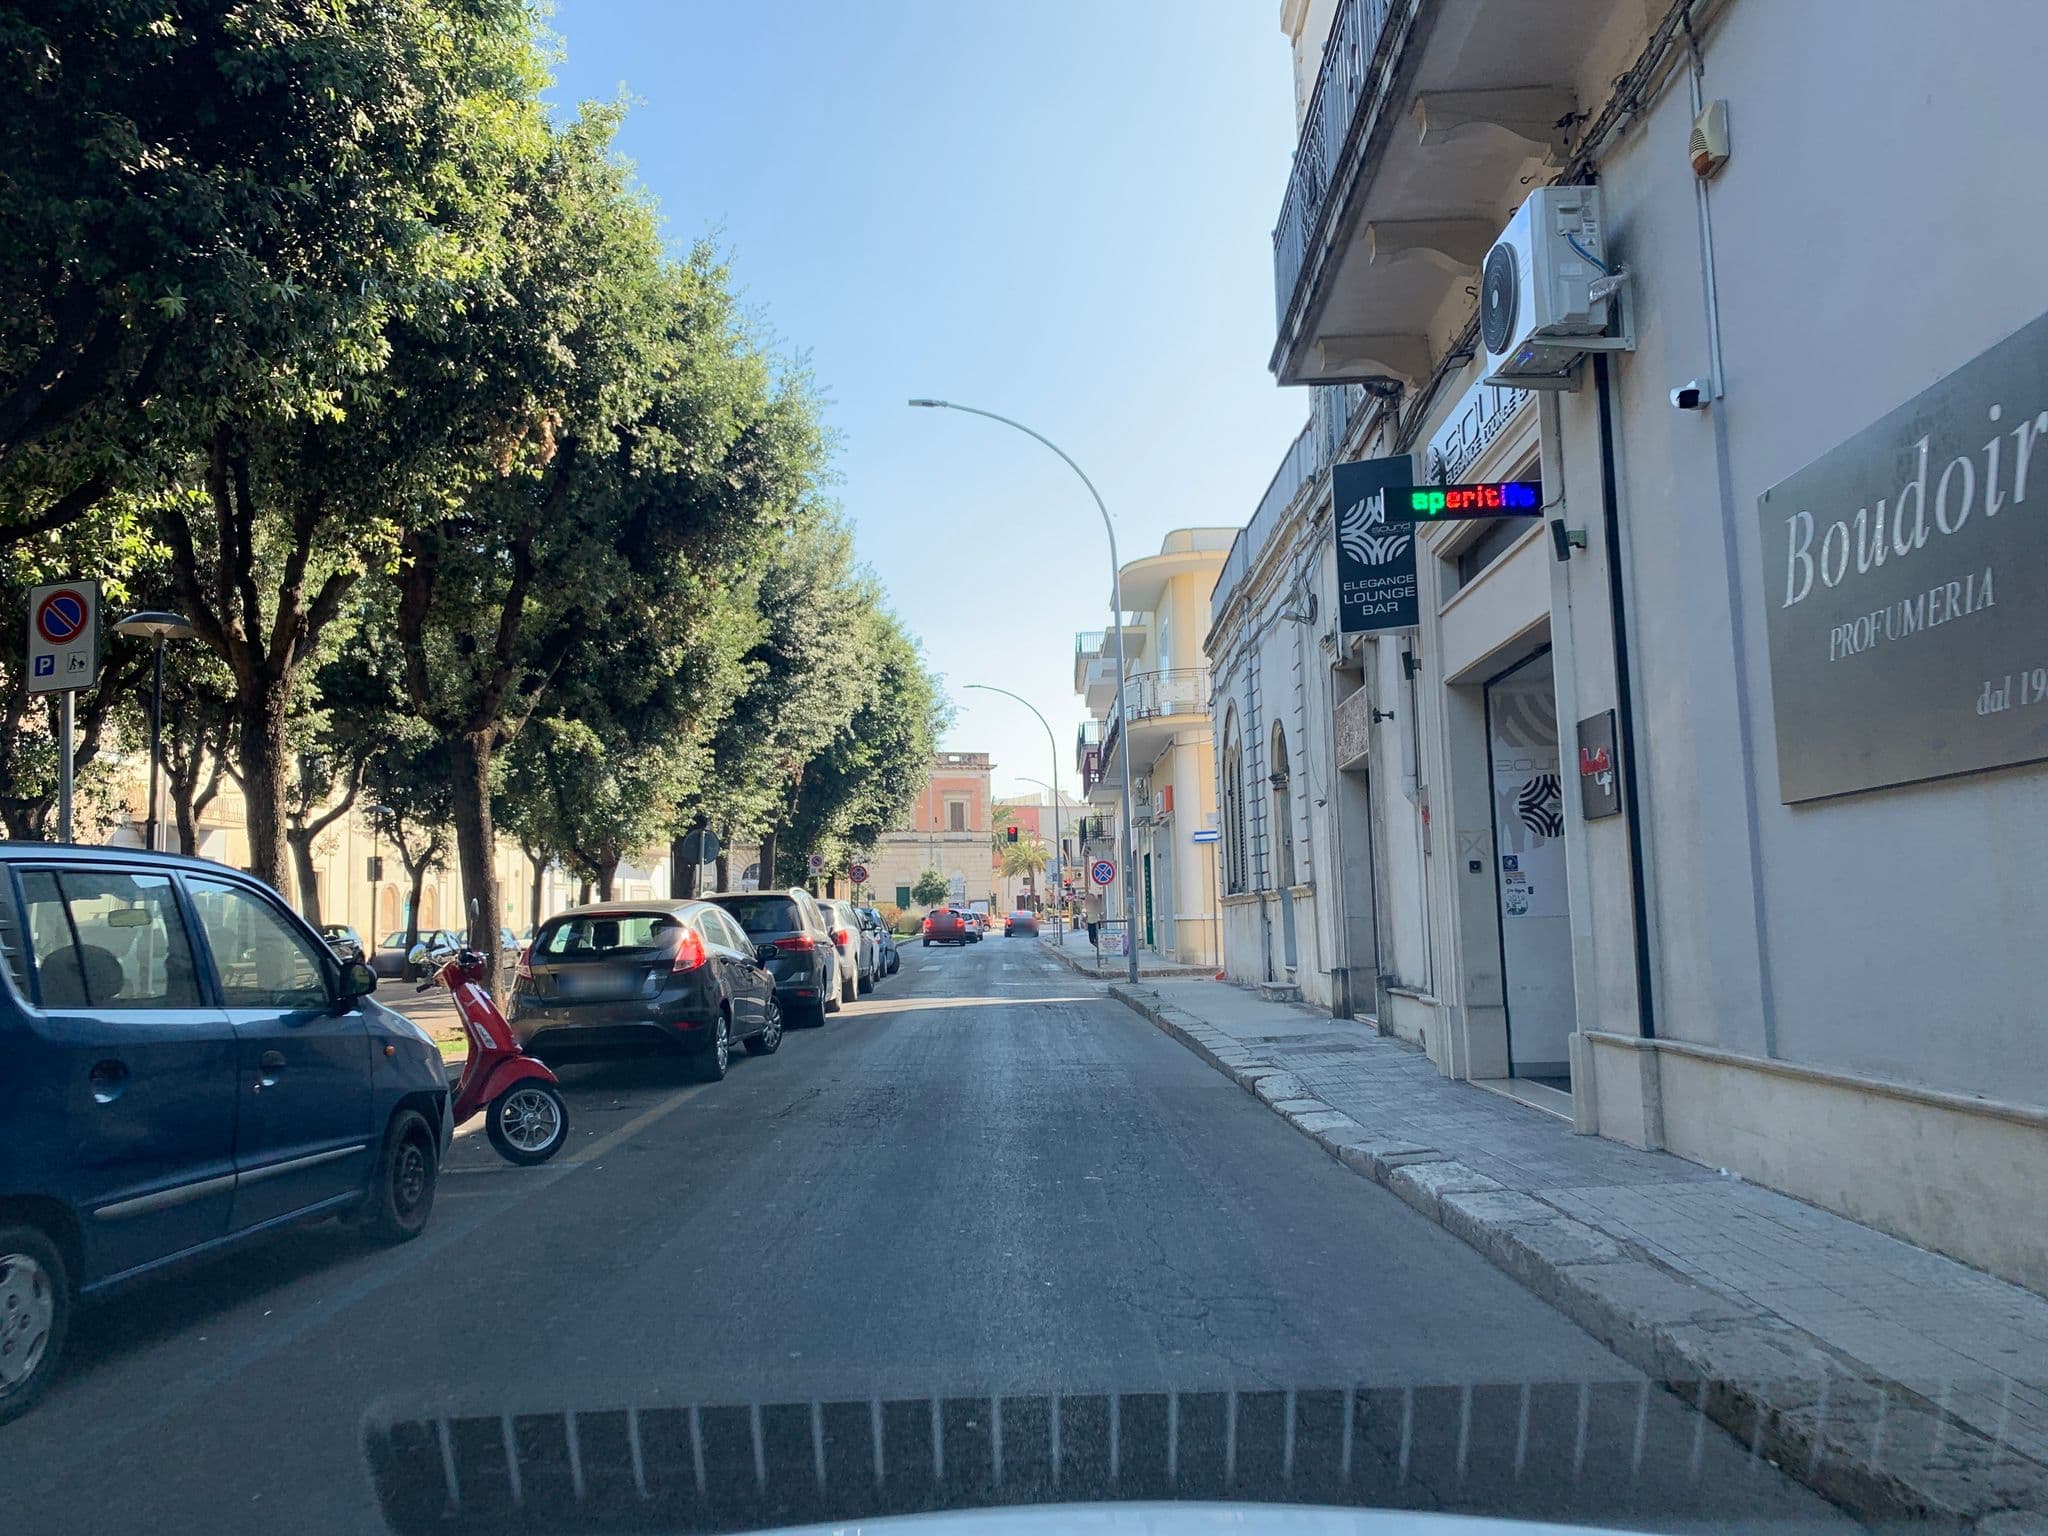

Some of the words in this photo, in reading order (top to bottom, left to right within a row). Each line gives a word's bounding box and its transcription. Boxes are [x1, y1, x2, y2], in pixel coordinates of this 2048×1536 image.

[1781, 403, 2048, 609] Boudoir
[1343, 573, 1416, 591] ELEGANCE
[1344, 586, 1416, 605] LOUNGE
[1362, 601, 1399, 616] BAR
[1828, 566, 1997, 663] PROFUMERIA
[39, 657, 51, 674] P
[1976, 675, 2012, 716] dal
[2021, 668, 2048, 705] 19
